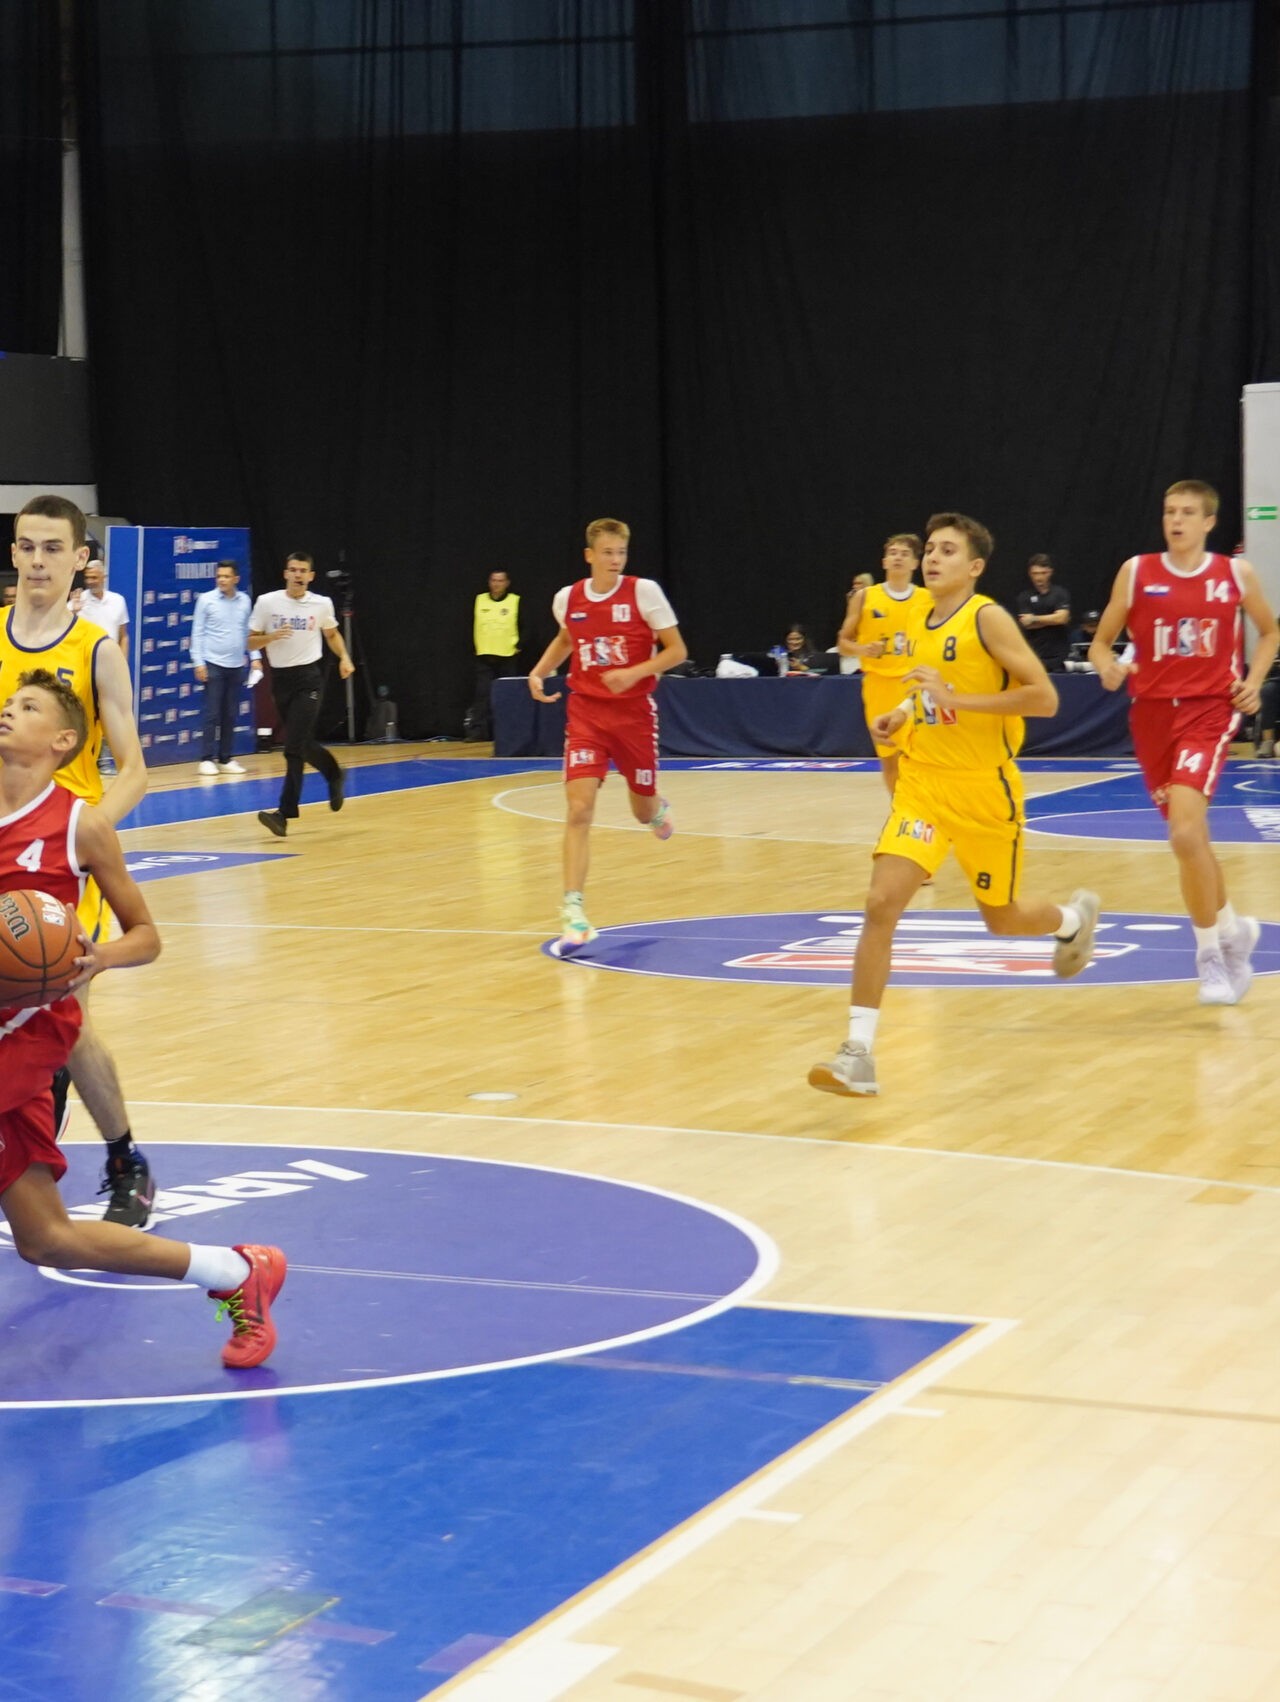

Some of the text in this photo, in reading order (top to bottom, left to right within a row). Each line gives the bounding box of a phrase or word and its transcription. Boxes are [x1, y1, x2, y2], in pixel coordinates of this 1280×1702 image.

[1205, 579, 1230, 603] 14
[612, 604, 631, 622] 10
[943, 635, 957, 661] 8
[1176, 748, 1204, 773] 14
[635, 769, 652, 786] 10
[15, 837, 45, 872] 4
[976, 872, 992, 890] 8
